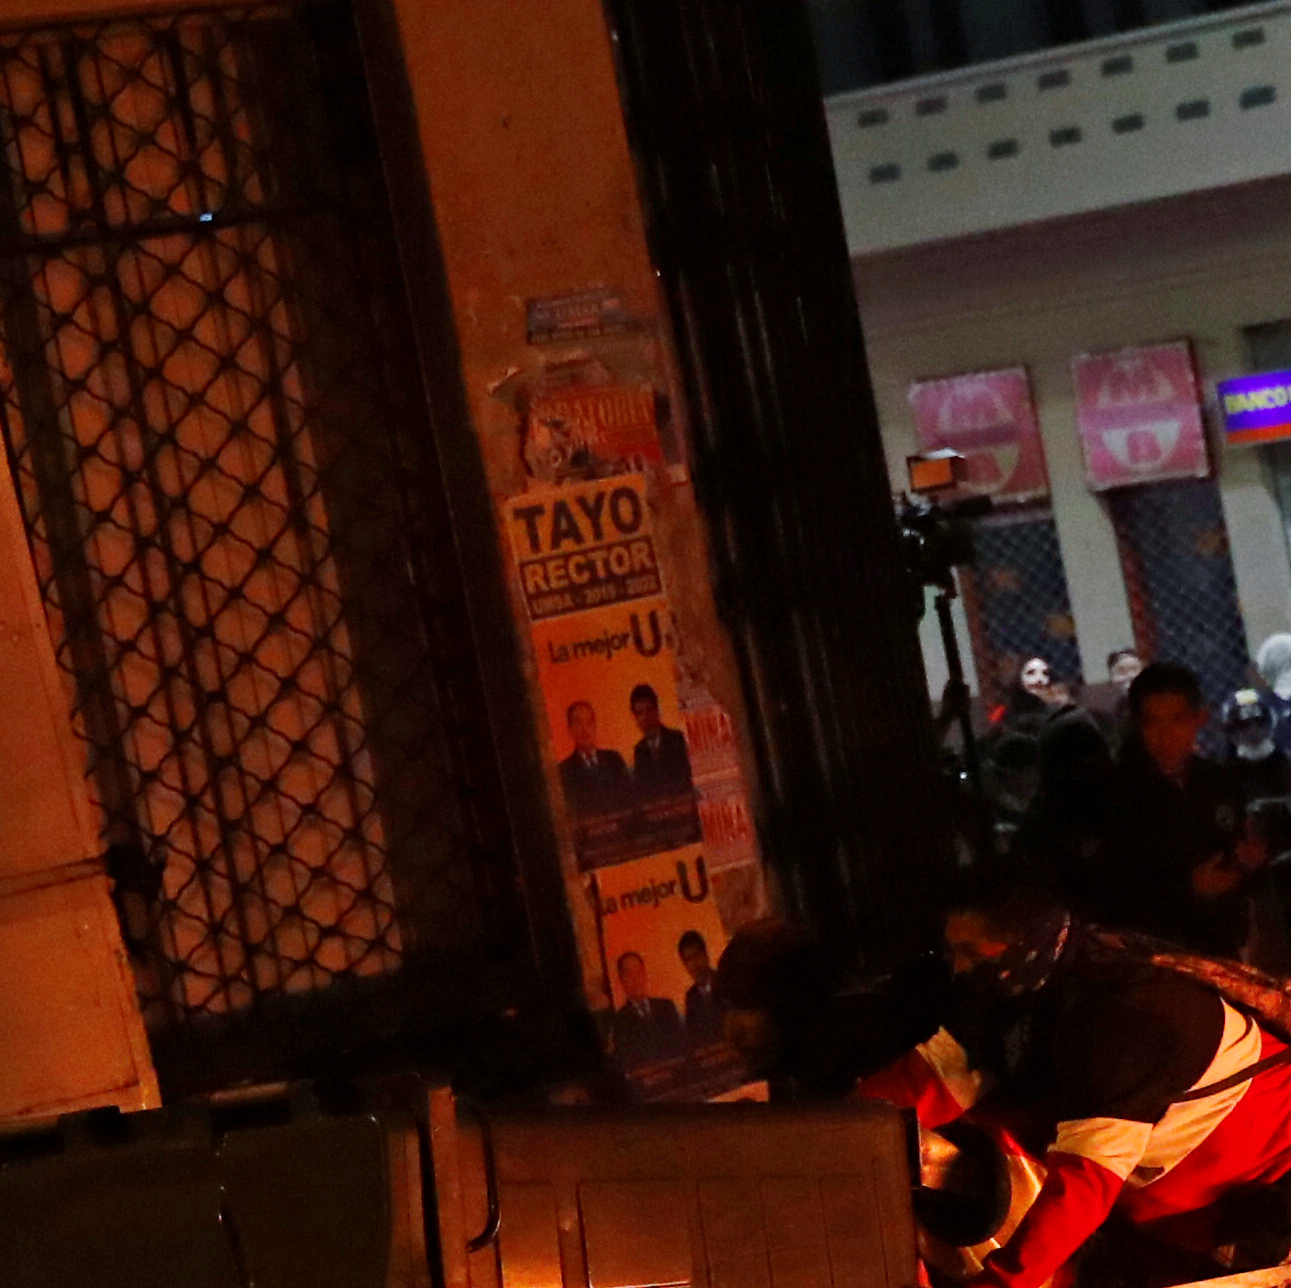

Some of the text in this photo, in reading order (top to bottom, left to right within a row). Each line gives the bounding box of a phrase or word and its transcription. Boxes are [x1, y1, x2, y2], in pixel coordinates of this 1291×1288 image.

[1223, 386, 1287, 414] BANCO
[514, 487, 641, 553] TAYO
[524, 542, 653, 593] RECTOR
[573, 630, 632, 660] mejor
[631, 611, 663, 657] U
[621, 879, 677, 912] mejor
[675, 855, 709, 904] U
